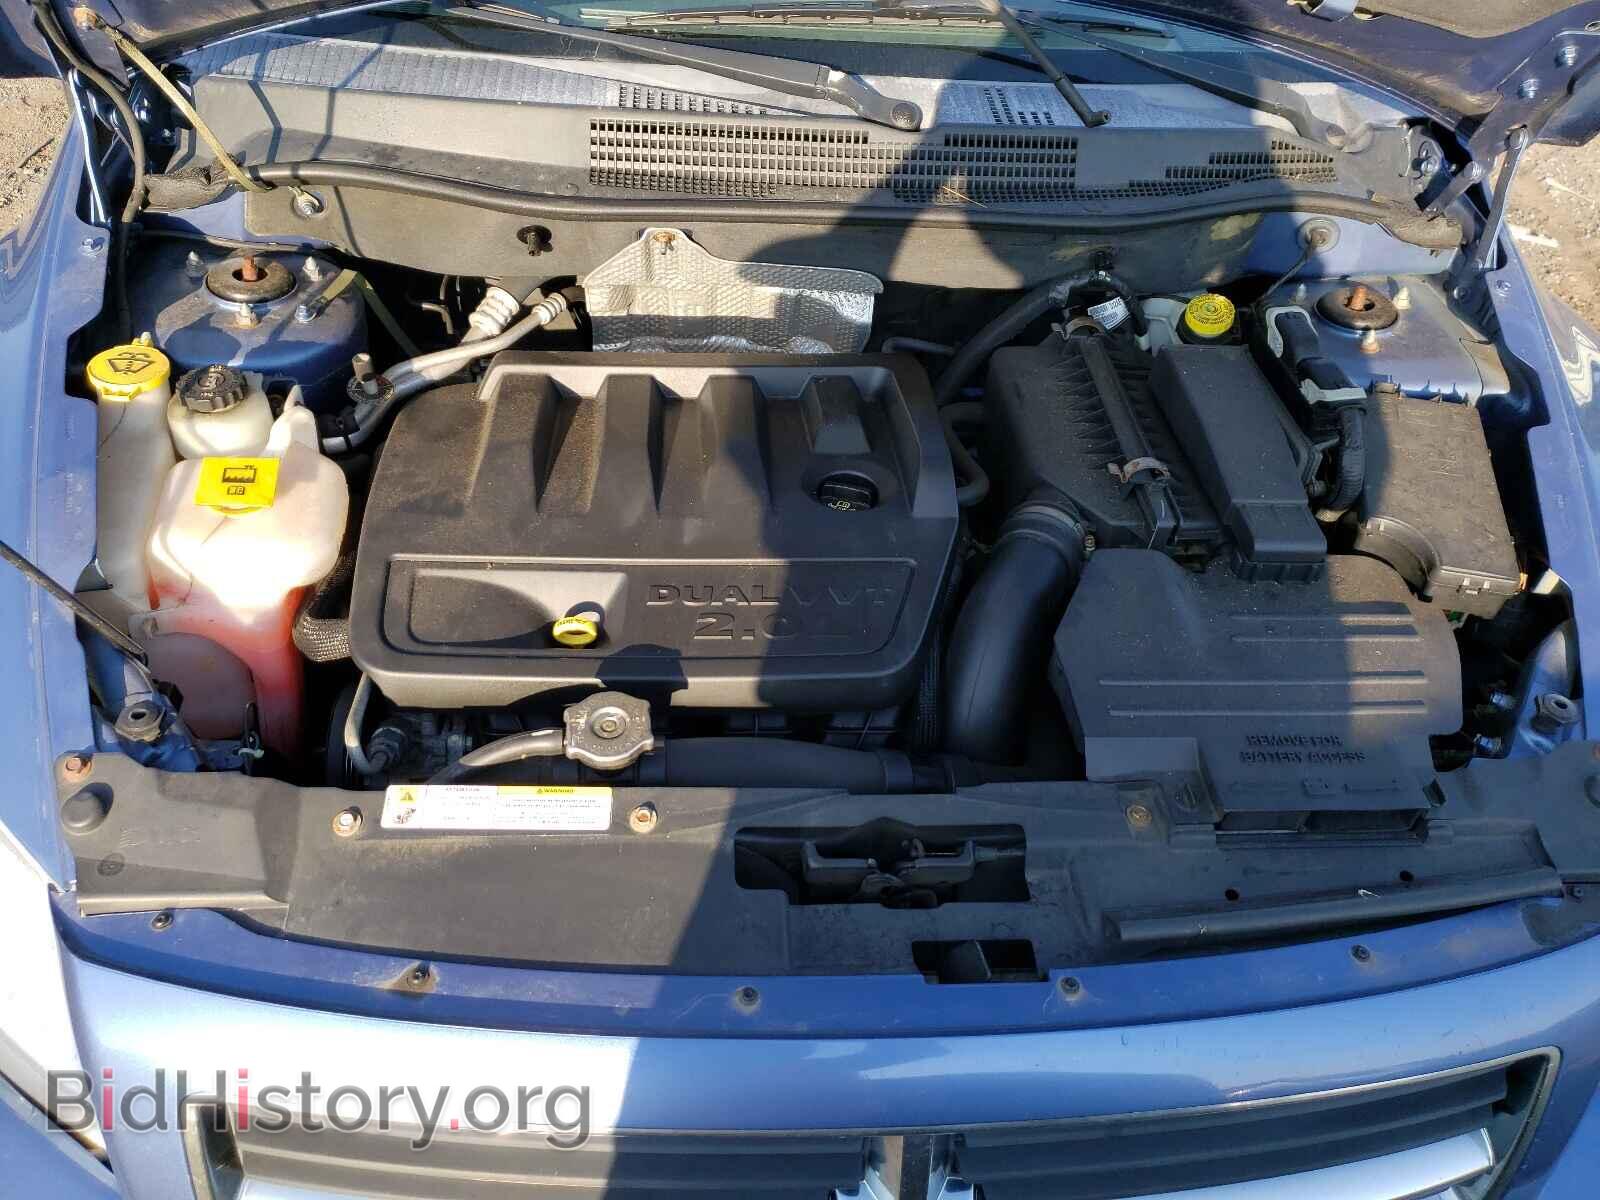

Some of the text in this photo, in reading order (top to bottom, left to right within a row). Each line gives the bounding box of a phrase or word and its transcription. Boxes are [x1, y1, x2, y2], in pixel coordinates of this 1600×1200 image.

[646, 584, 780, 606] DUAL
[1246, 735, 1344, 746] REMOVE FOR
[1239, 751, 1368, 763] BATTERY ACCESS
